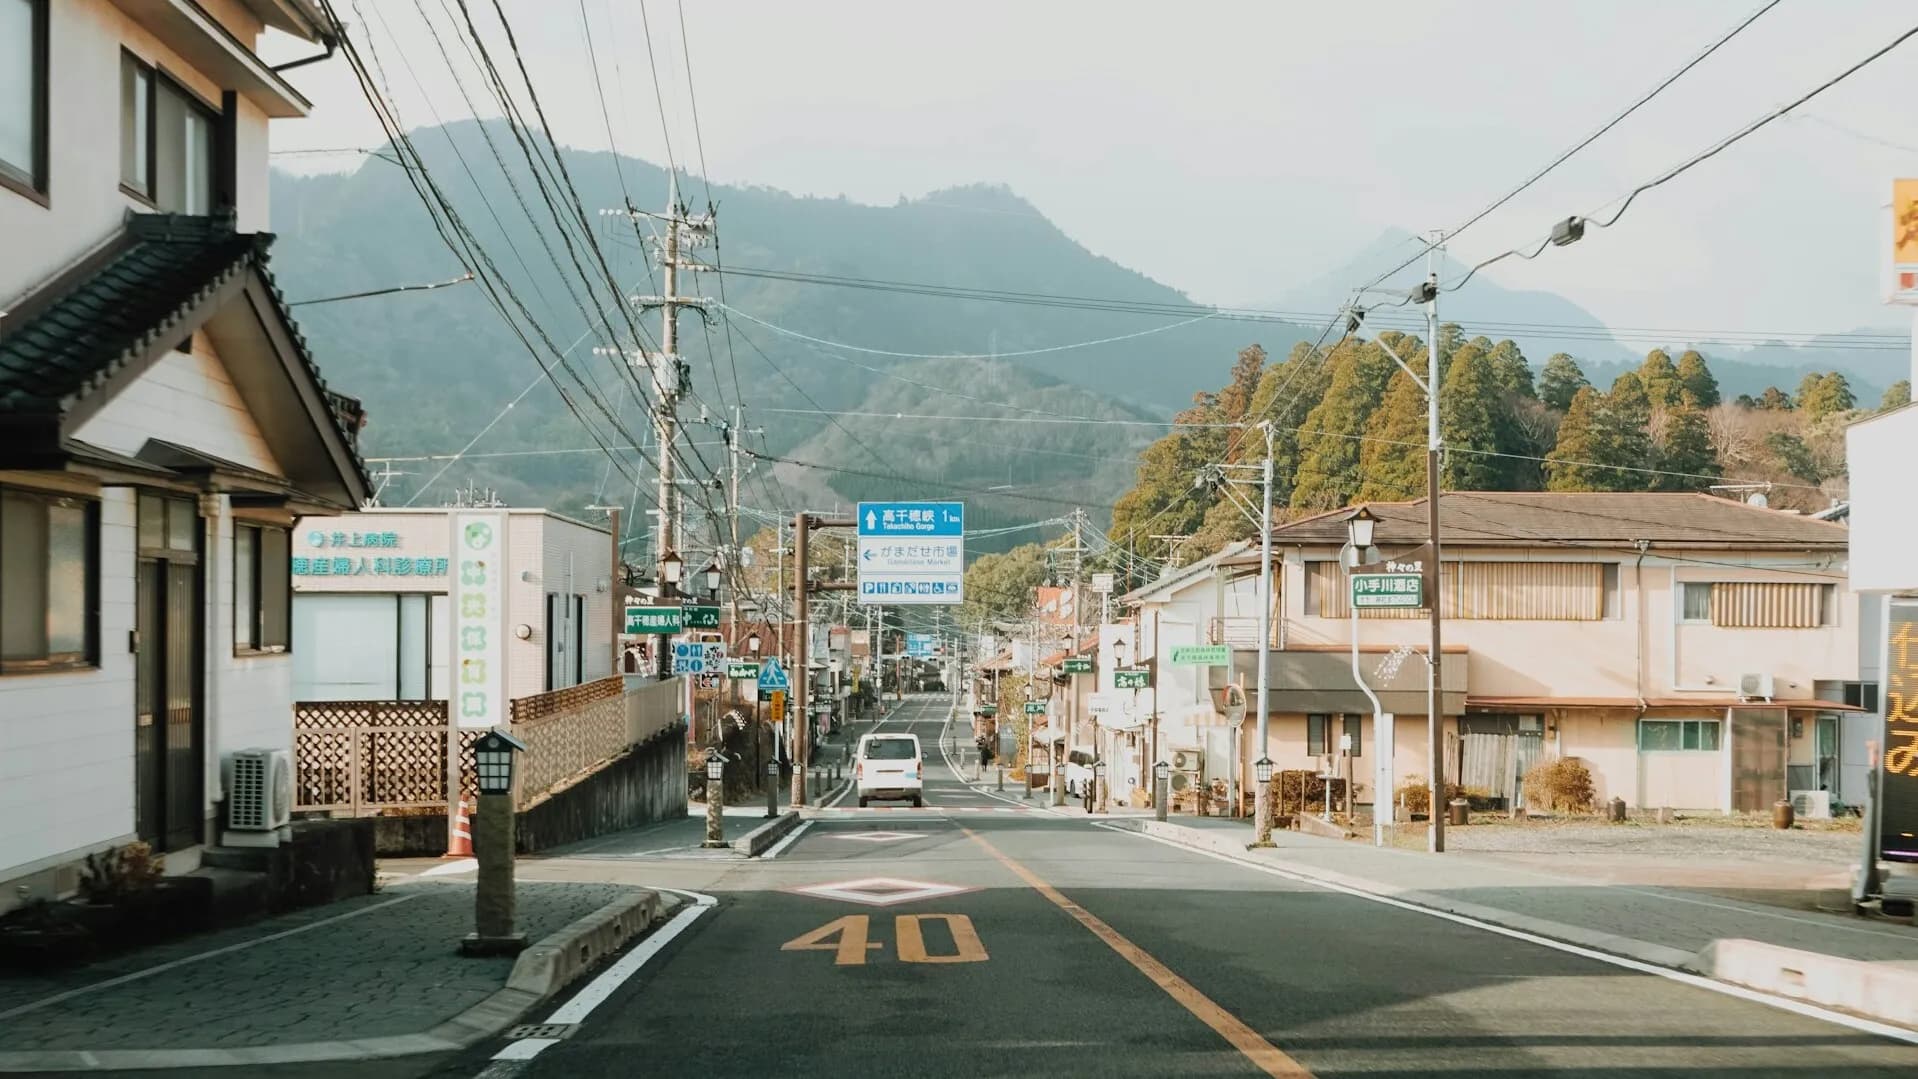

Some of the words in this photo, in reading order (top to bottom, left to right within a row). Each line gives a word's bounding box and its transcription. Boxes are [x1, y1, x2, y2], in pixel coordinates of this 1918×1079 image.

[942, 509, 948, 522] 1
[916, 523, 935, 531] Gorge
[331, 532, 397, 548] 井上病院
[780, 914, 990, 965] 40
